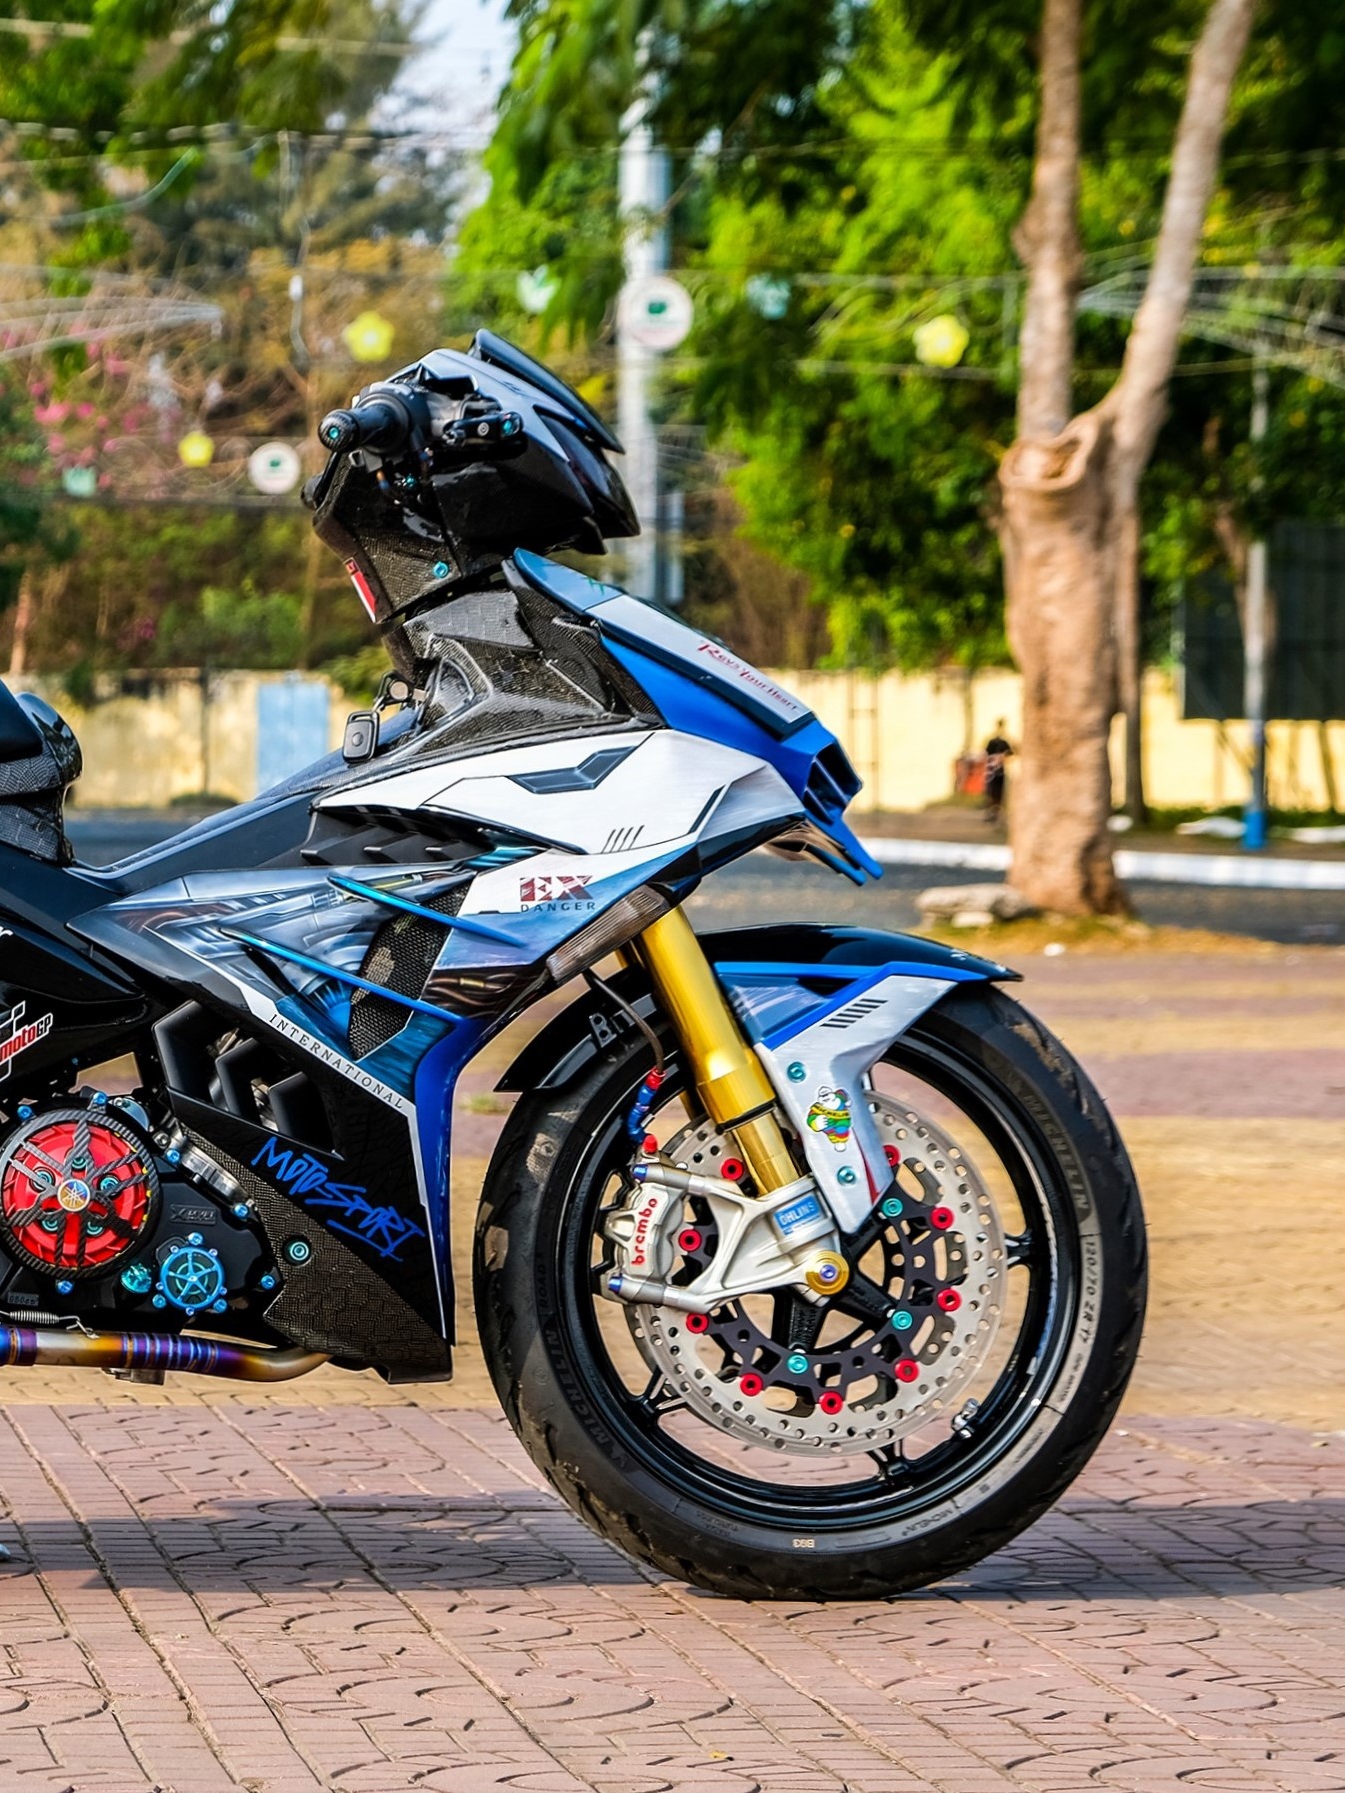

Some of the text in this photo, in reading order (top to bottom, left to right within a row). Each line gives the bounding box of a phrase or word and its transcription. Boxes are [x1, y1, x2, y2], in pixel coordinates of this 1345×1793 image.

[519, 875, 594, 903] EX
[520, 901, 596, 914] DANGER
[267, 1012, 405, 1110] INTERNATIONAL
[631, 1197, 658, 1266] brembo
[1084, 1239, 1097, 1295] 120/70
[544, 1327, 611, 1447] MICHELIN
